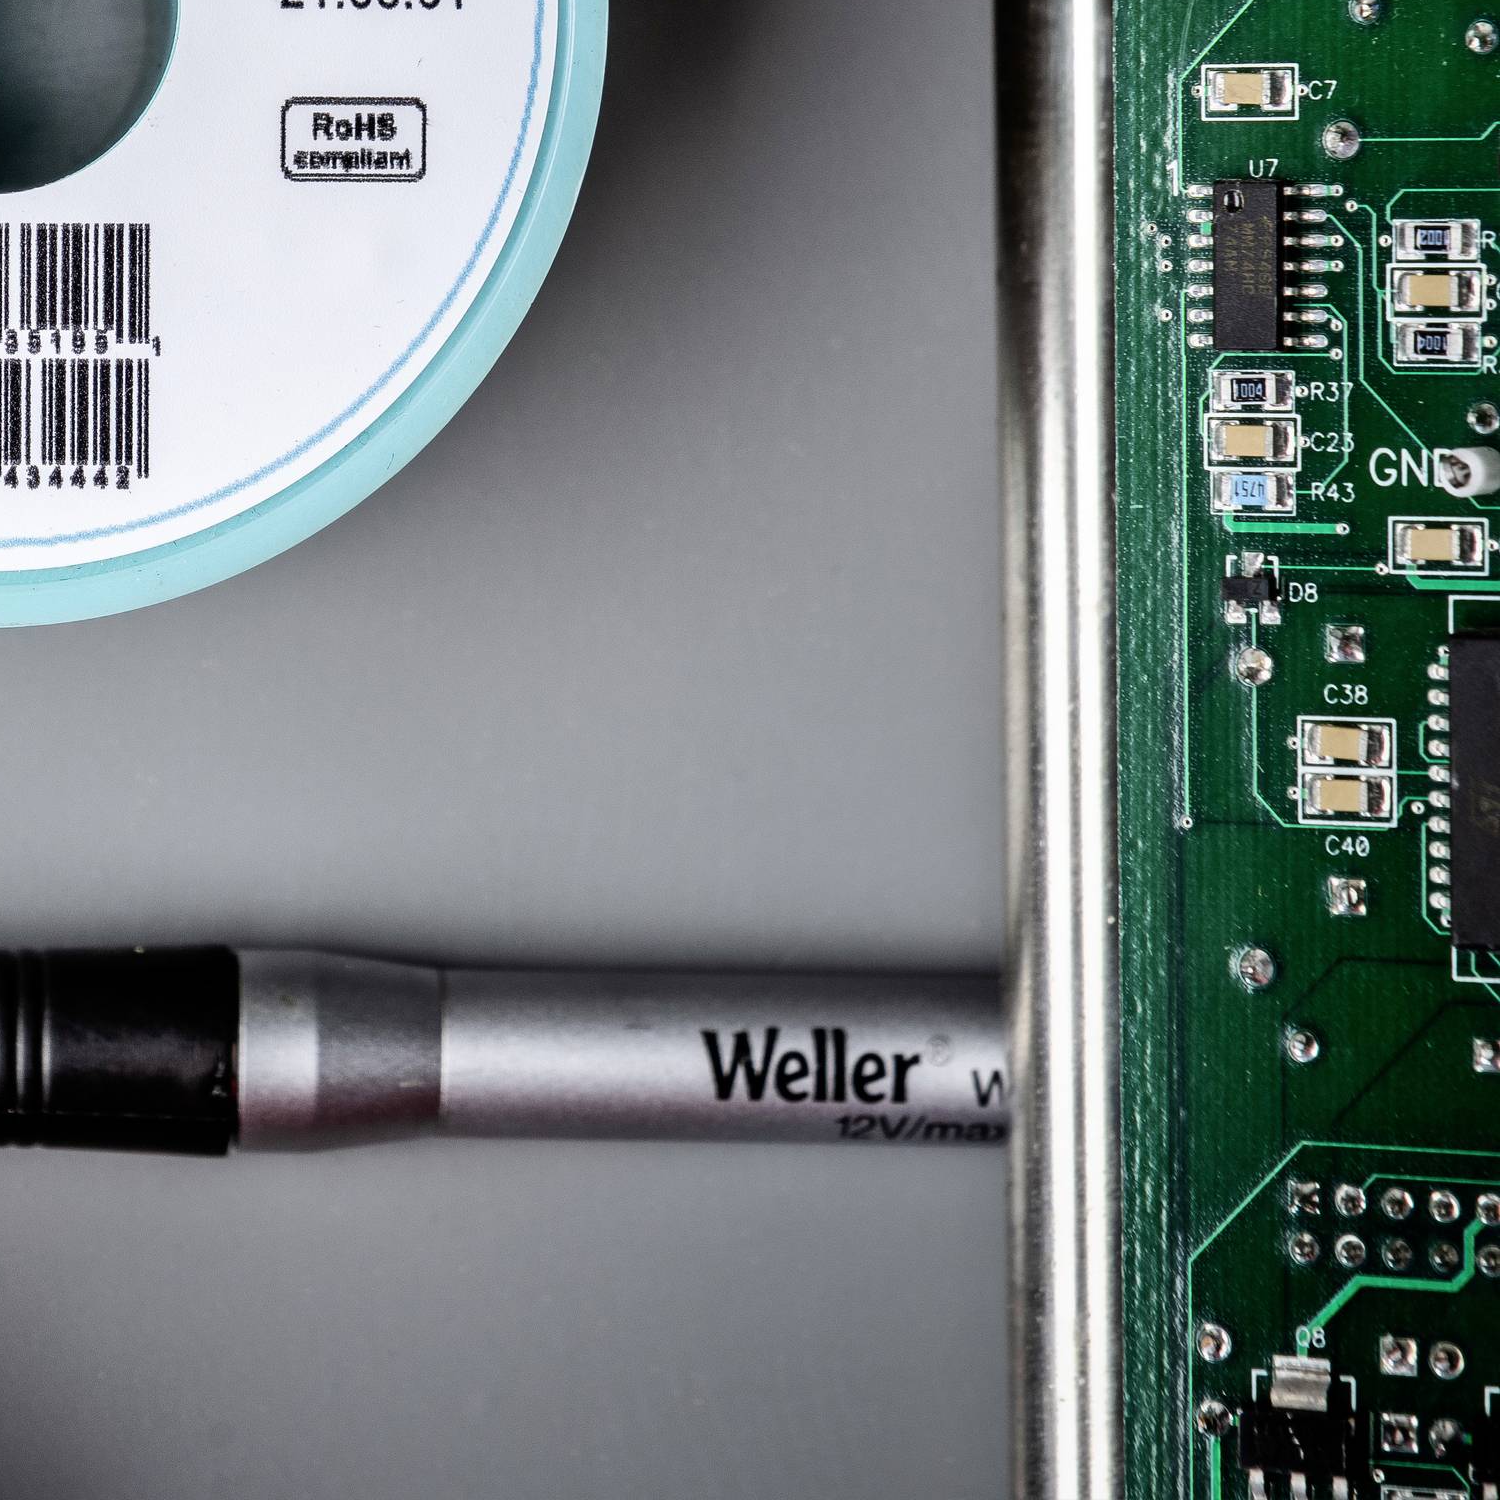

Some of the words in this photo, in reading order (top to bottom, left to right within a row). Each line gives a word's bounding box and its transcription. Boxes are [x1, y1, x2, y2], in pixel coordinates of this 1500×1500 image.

[1308, 80, 1338, 100] C7
[312, 112, 397, 142] RoHS
[1248, 158, 1280, 179] U7
[1310, 381, 1354, 402] R37
[1310, 432, 1355, 453] C23
[1311, 482, 1356, 503] R43
[1289, 582, 1319, 603] D8
[1323, 683, 1369, 705] C38
[1325, 834, 1370, 857] C40
